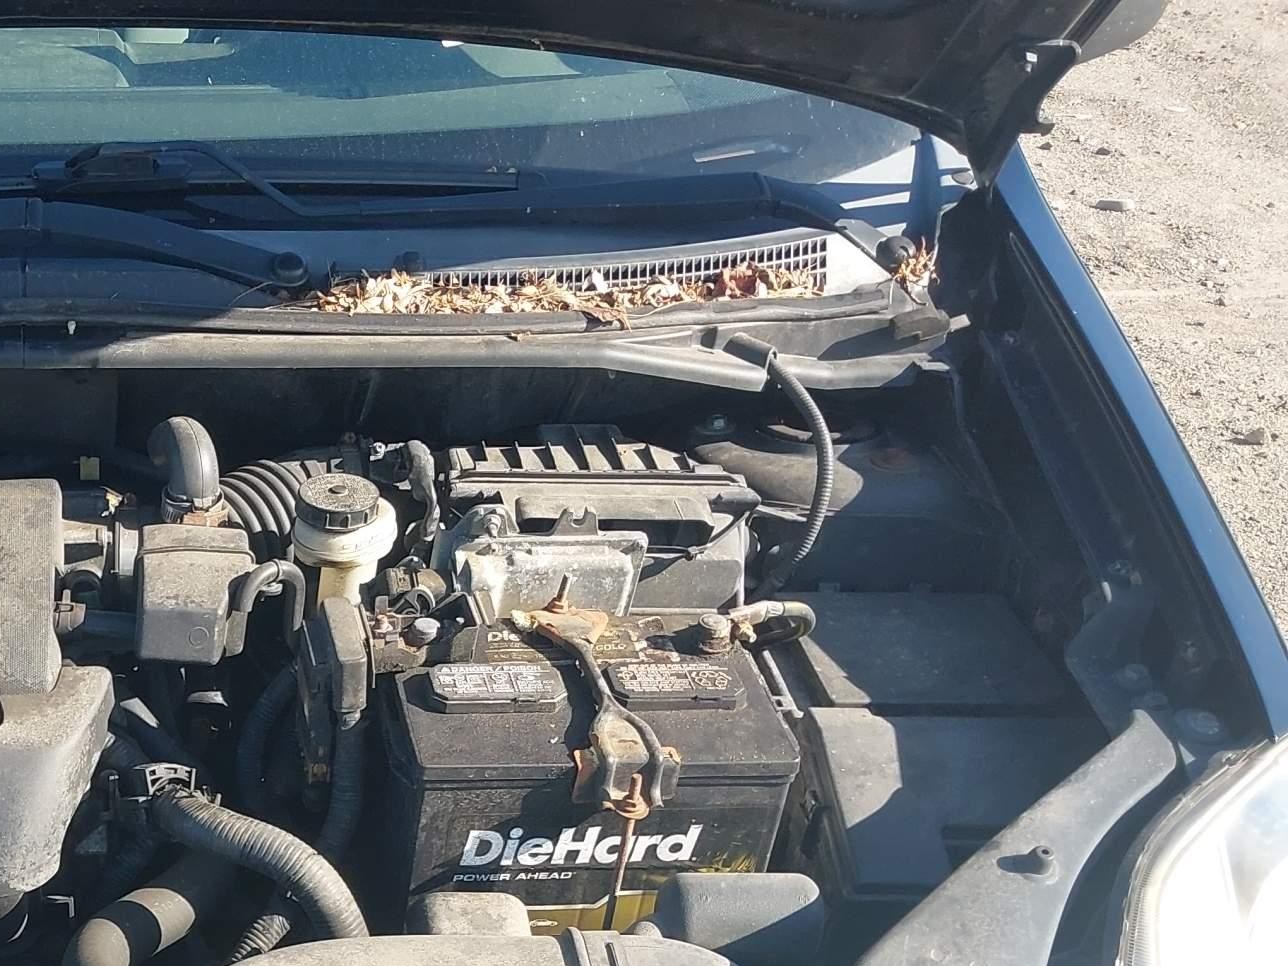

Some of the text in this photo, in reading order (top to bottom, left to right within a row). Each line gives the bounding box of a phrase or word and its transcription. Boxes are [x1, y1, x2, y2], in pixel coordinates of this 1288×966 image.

[595, 643, 627, 652] GOLD
[459, 824, 704, 867] DieHard
[453, 872, 572, 882] POWER AHEAD
